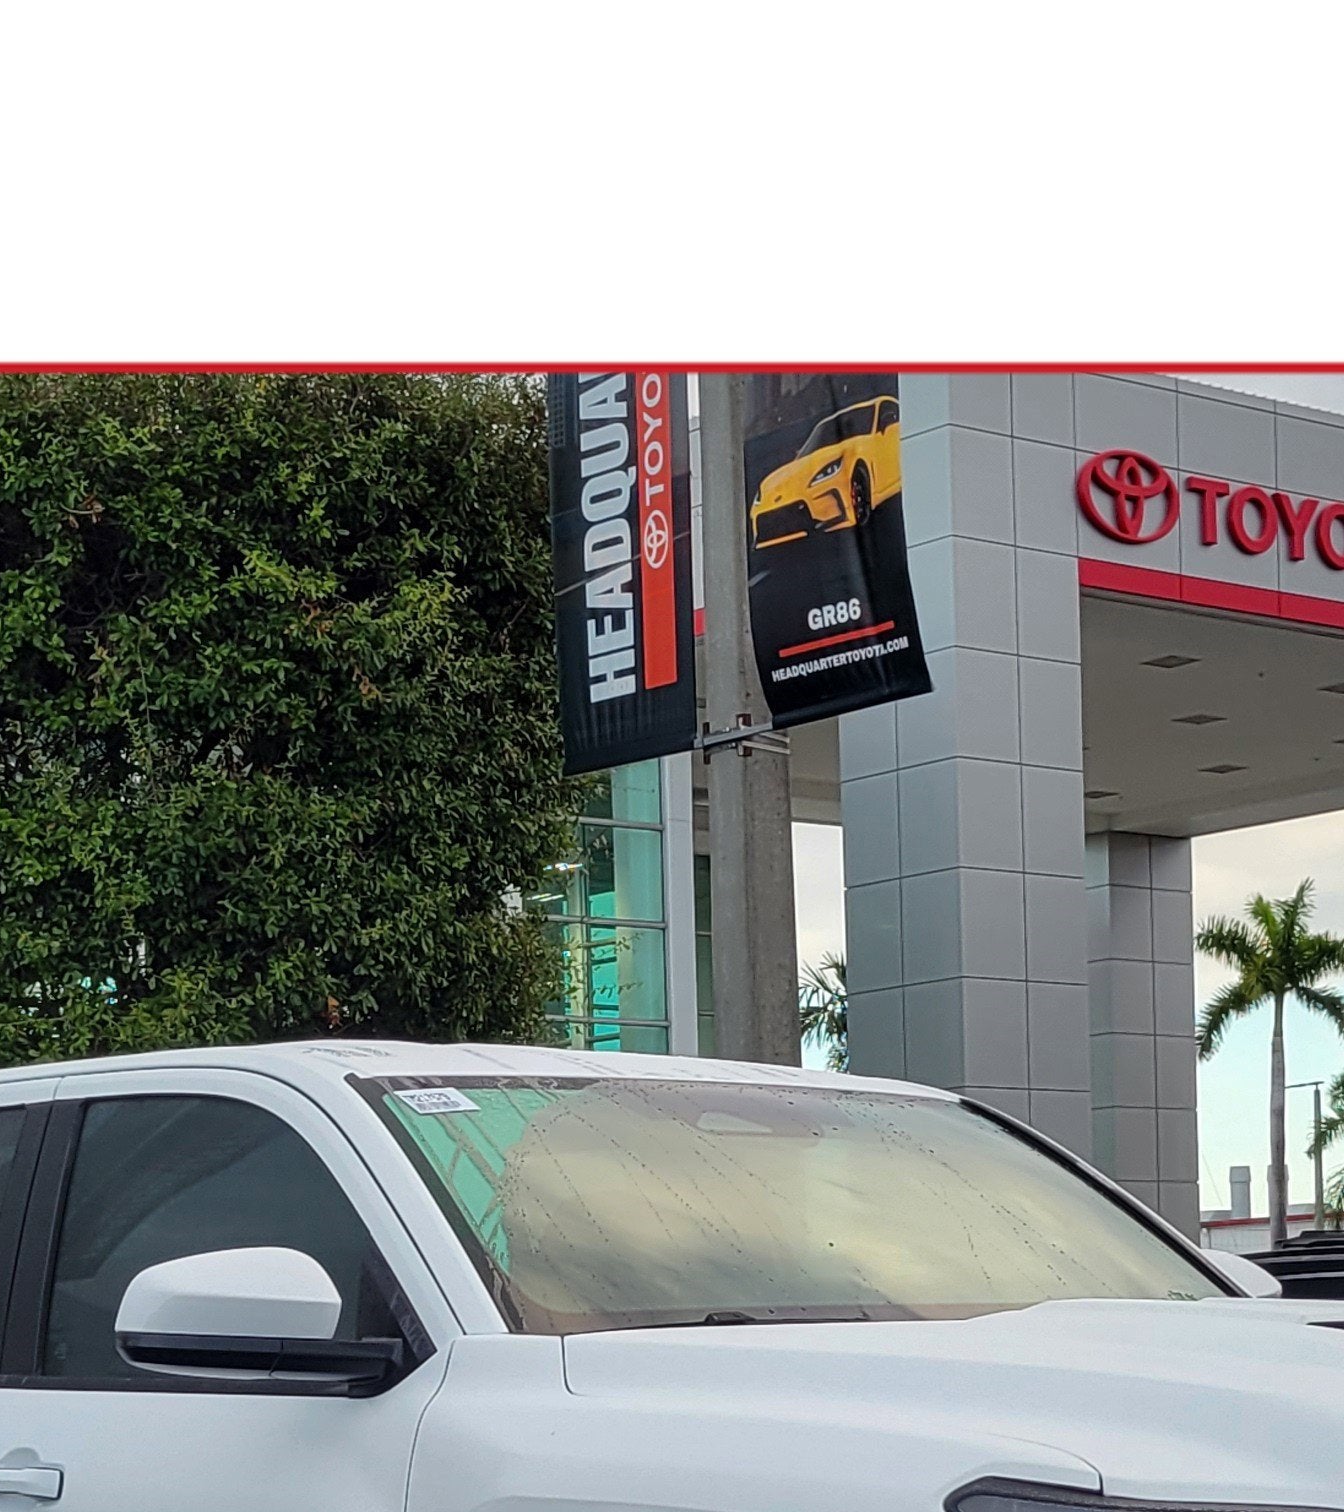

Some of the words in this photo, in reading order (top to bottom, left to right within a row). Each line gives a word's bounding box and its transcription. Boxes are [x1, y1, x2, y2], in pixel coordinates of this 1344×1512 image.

[641, 372, 665, 507] TOYO
[578, 372, 637, 703] HEADQUA
[807, 598, 862, 631] GR86
